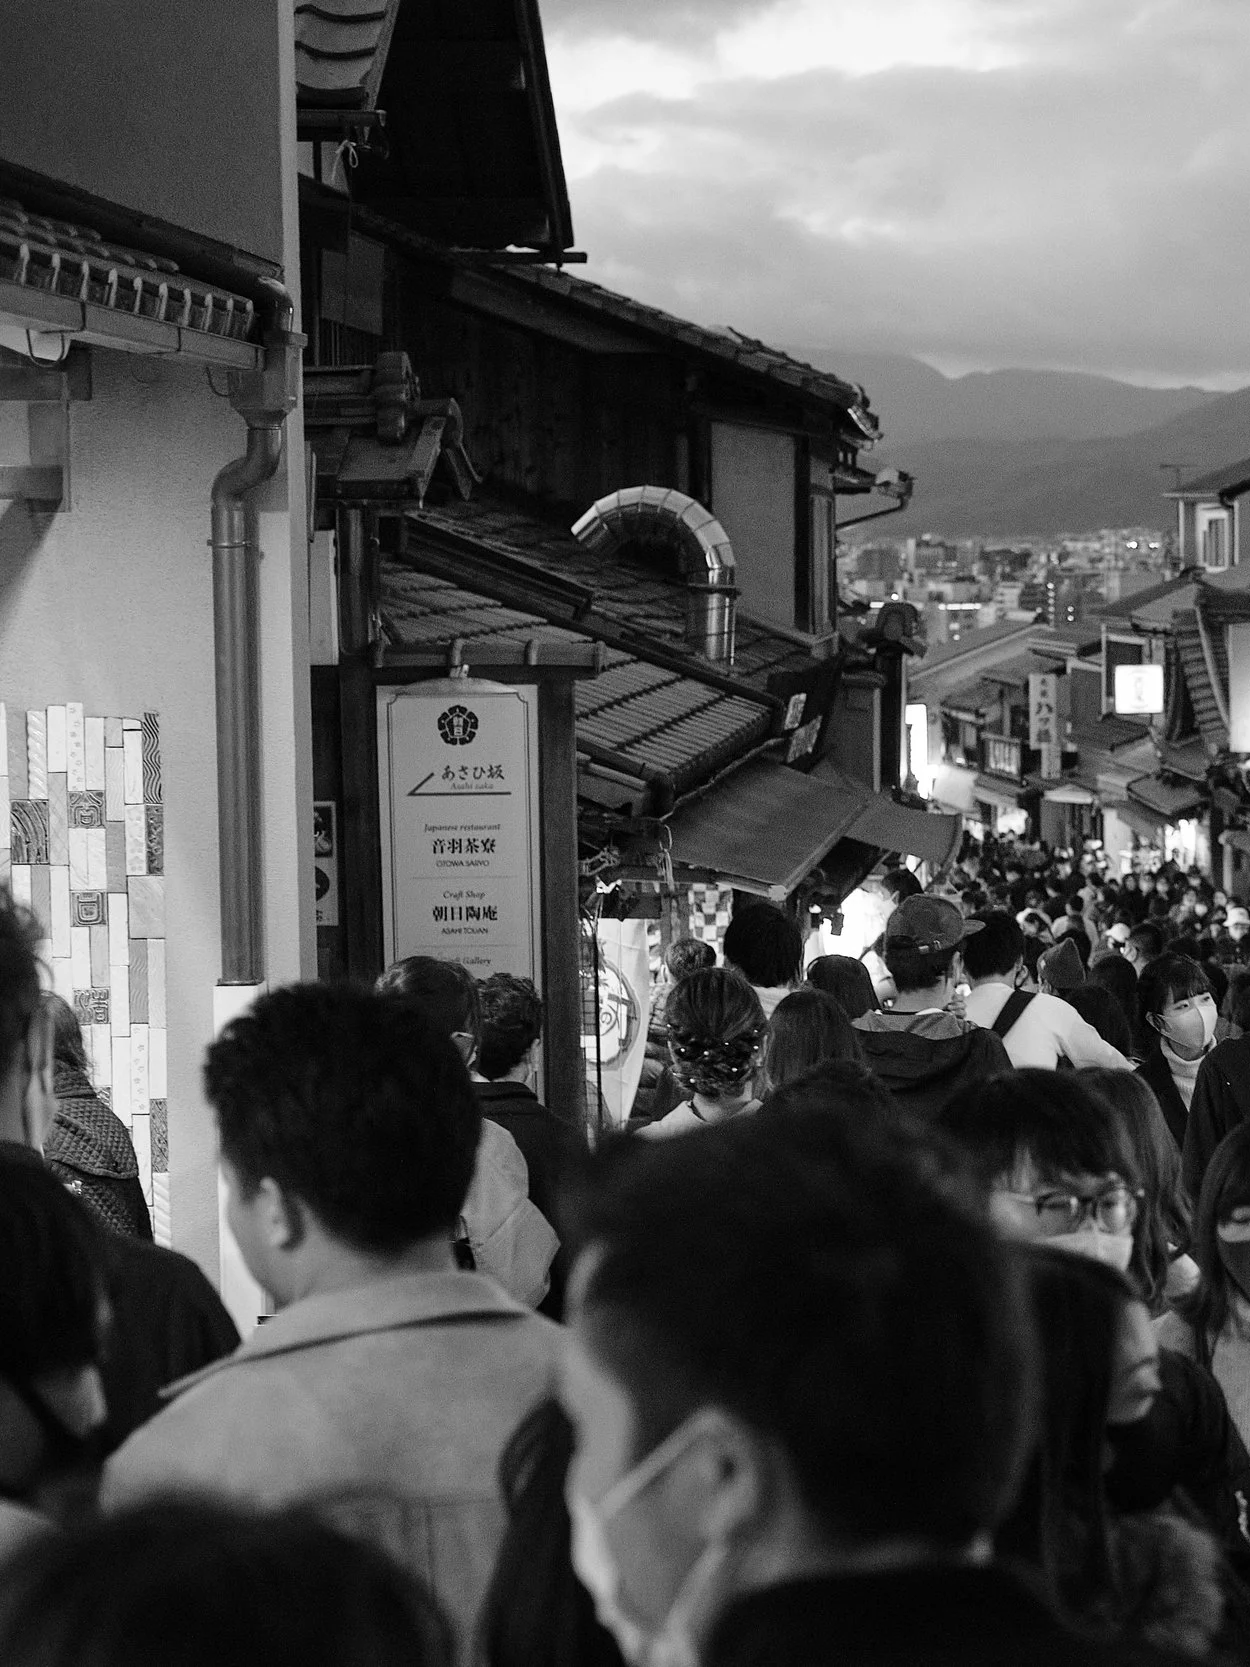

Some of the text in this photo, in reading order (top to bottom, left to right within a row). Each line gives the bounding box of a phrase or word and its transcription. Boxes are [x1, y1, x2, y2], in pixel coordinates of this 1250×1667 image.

[441, 764, 505, 781] あさひ坂
[424, 823, 501, 833] Japanese restaurant
[442, 890, 486, 901] Craft Shop
